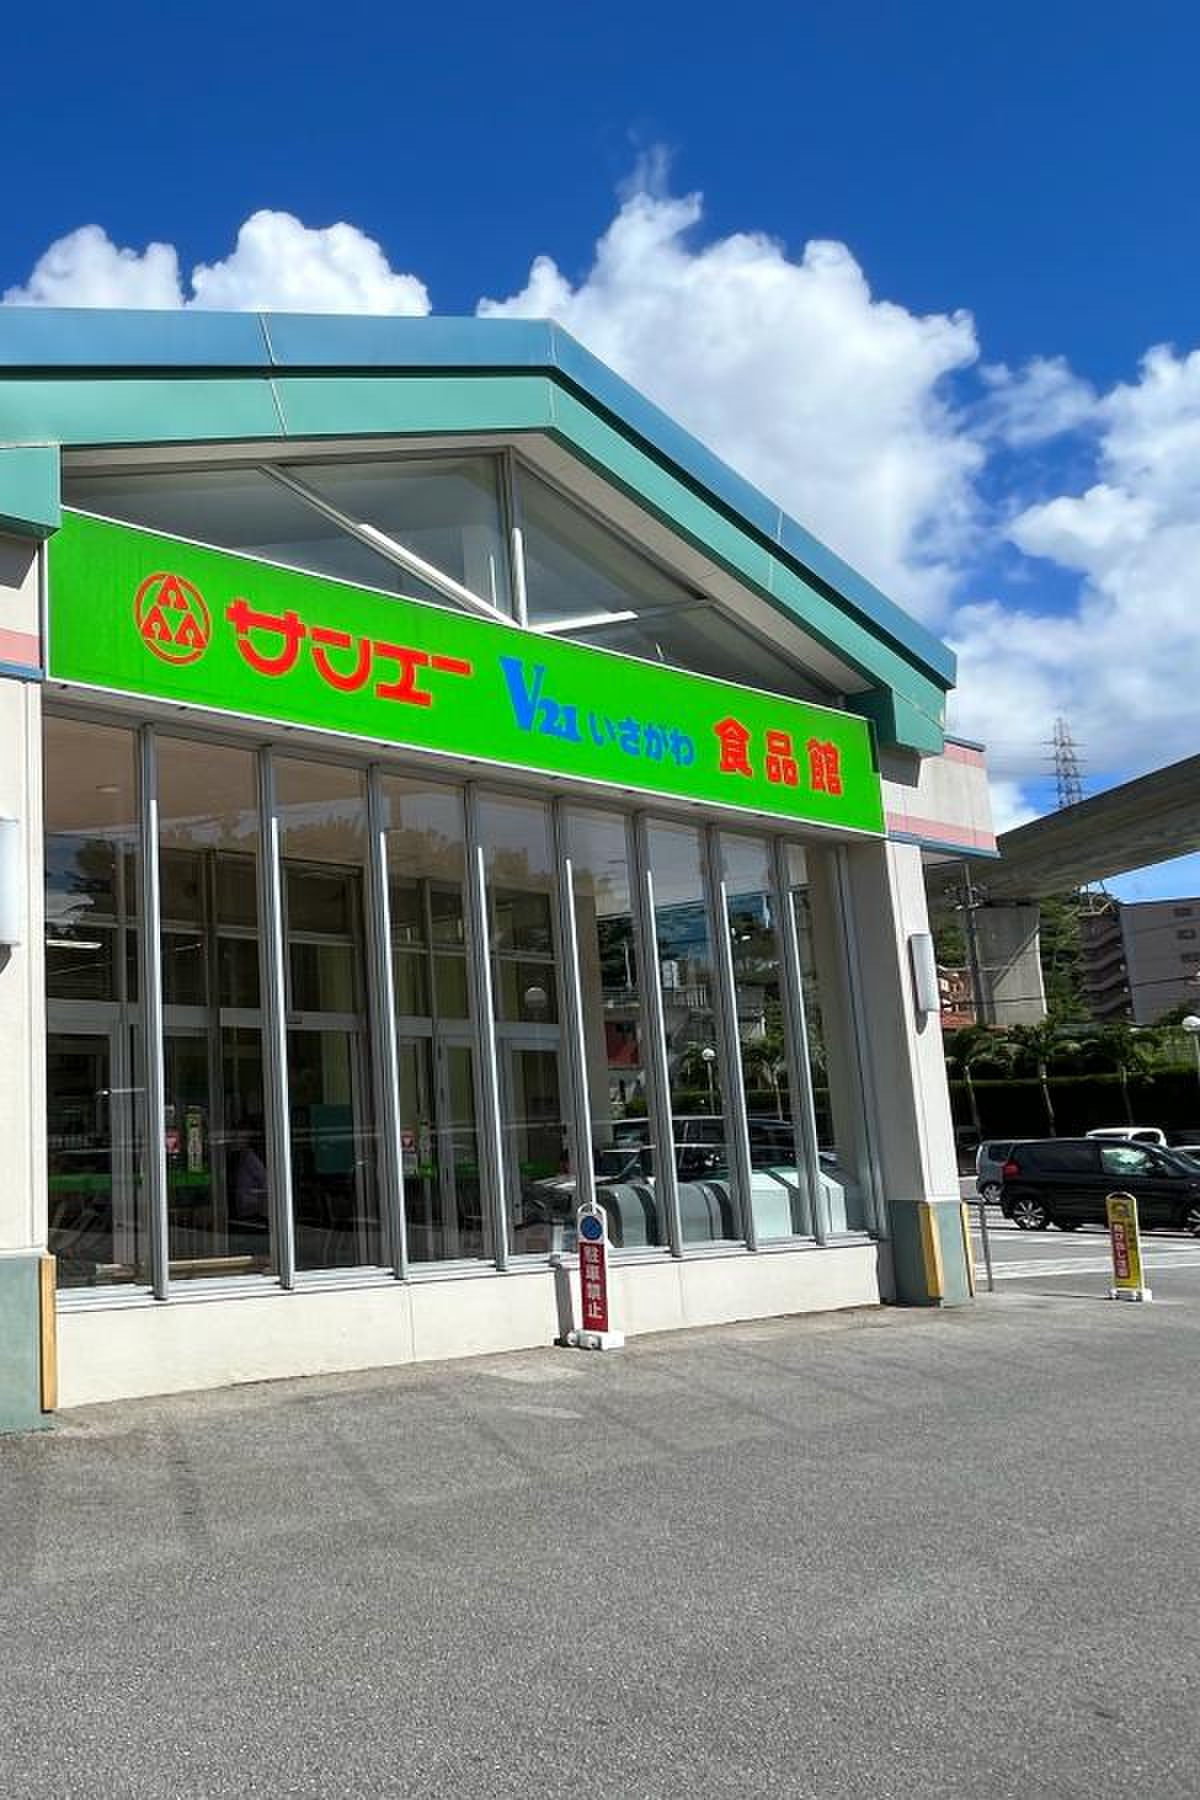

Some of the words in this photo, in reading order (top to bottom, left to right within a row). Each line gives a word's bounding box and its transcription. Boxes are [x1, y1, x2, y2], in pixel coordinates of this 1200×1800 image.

[226, 598, 472, 706] サンエー
[499, 656, 582, 742] V21
[587, 712, 694, 766] いさがわ
[714, 716, 842, 795] 食品館
